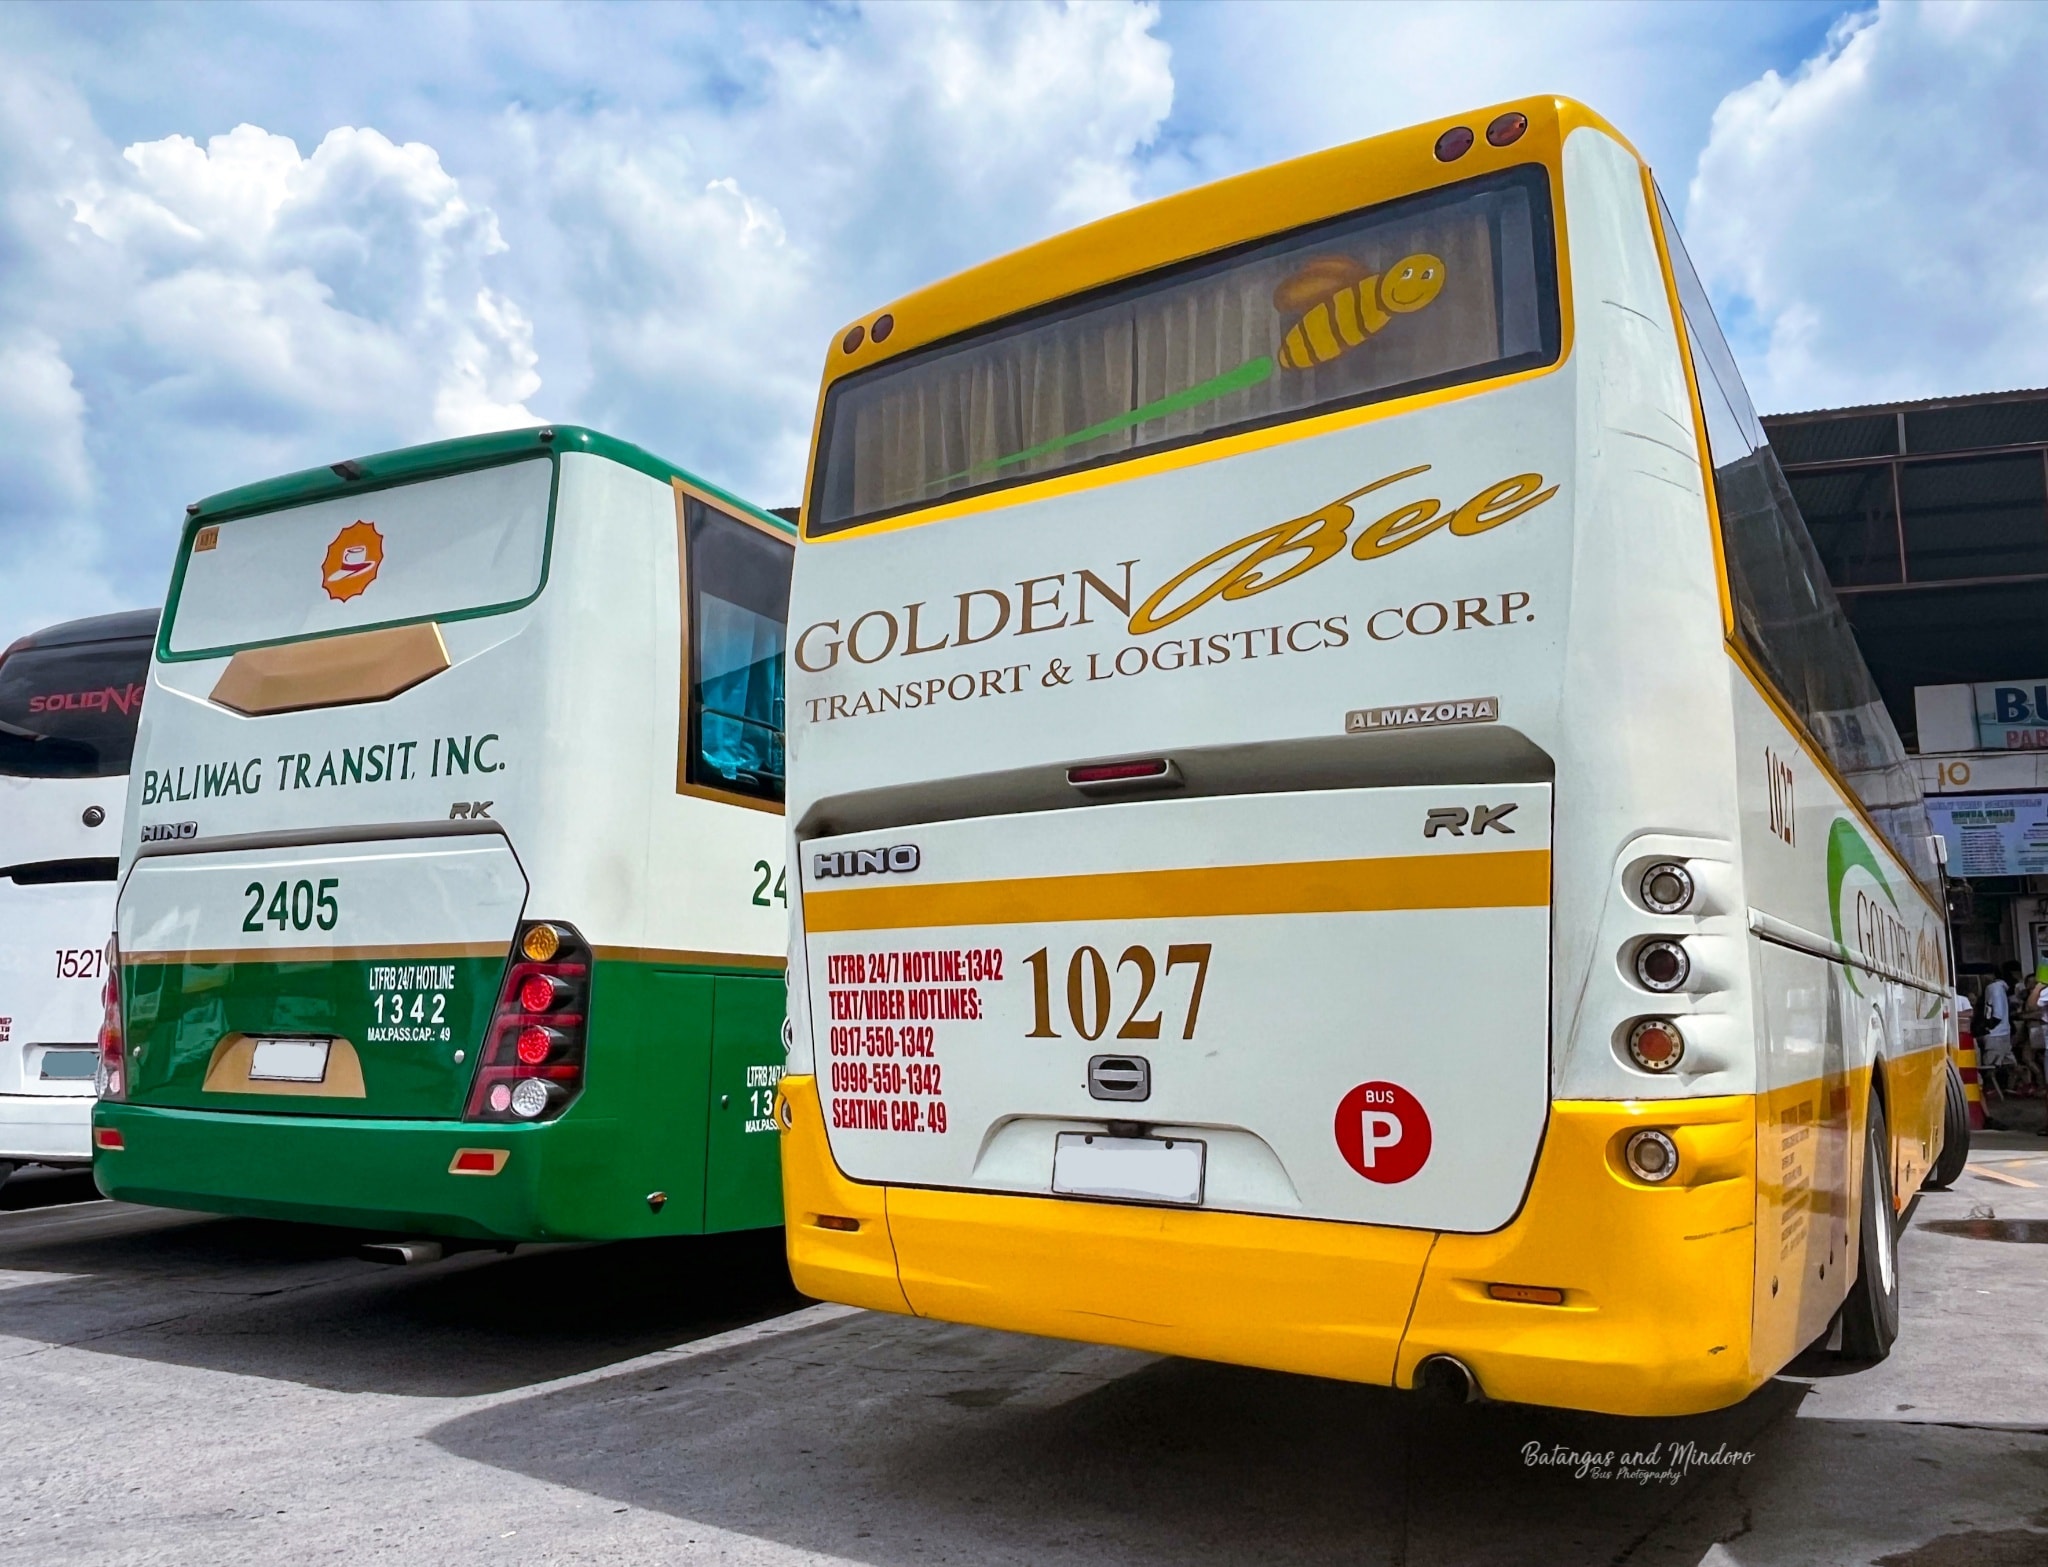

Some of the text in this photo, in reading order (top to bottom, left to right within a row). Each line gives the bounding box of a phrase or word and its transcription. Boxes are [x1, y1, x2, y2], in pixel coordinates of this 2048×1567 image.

[794, 463, 1560, 673] GOLDEN Bee
[805, 591, 1535, 723] TRANSPORT & LOGISTICS CORP.
[1349, 700, 1494, 729] ALMAZORA
[142, 733, 506, 805] BALIWAG TRANSIT, INC.
[450, 801, 494, 819] RK
[1423, 803, 1519, 838] RK
[141, 820, 198, 842] HINO
[813, 844, 920, 878] HINO
[242, 878, 339, 932] 2405
[56, 949, 102, 979] 1521
[369, 965, 455, 990] LTFRB 24/7 HOTLINE
[828, 953, 866, 984] LTFRB
[868, 952, 900, 984] 24/7
[828, 987, 983, 1020] TEXT/VIBER HOTLINES:
[1022, 943, 1212, 1041] 1027
[440, 1026, 451, 1041] 49
[830, 1025, 935, 1058] 0917-550-1342
[831, 1062, 942, 1095] 0998-550-1342
[1366, 1090, 1395, 1104] BUS
[833, 1098, 888, 1130] SEATING
[927, 1101, 947, 1134] 49
[1361, 1110, 1403, 1168] P
